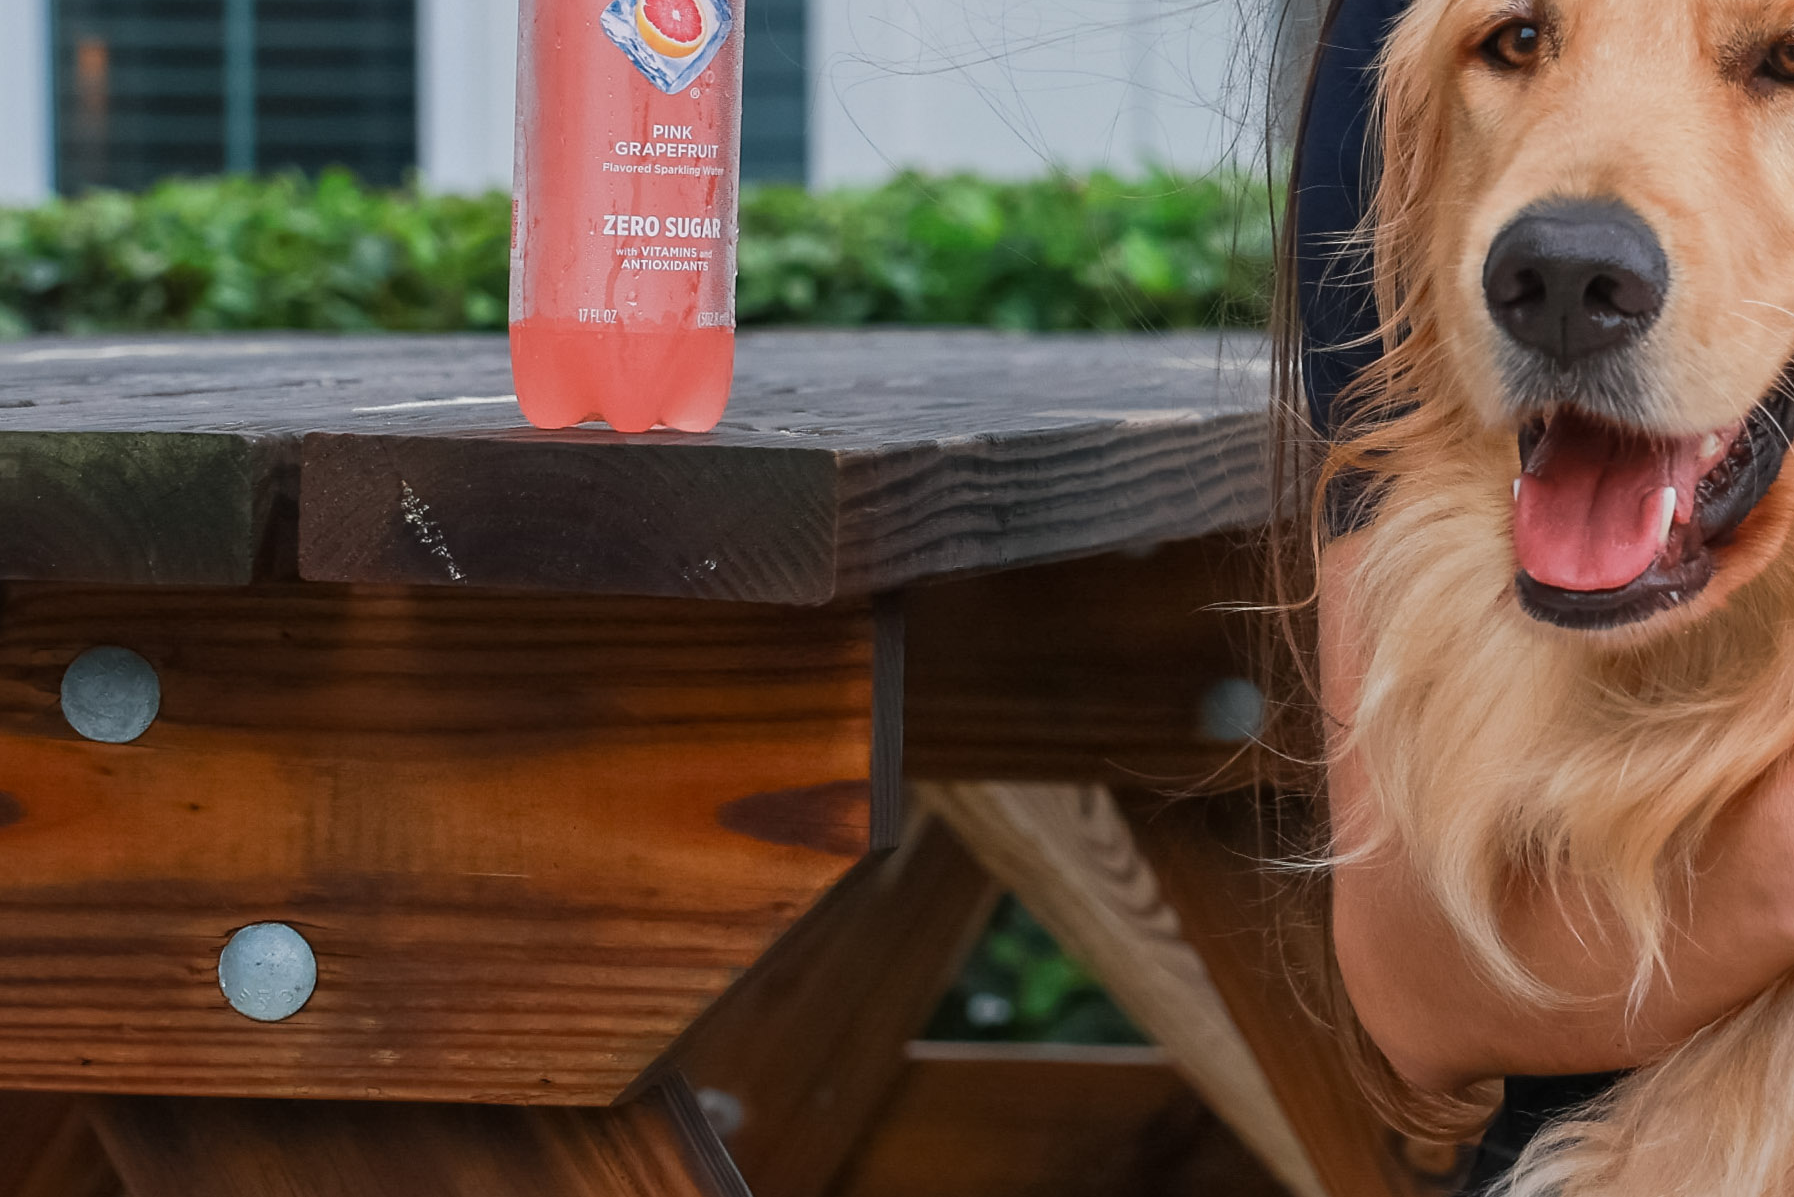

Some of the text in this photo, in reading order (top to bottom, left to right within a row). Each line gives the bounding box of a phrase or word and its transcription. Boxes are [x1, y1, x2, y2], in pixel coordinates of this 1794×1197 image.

[653, 124, 693, 140] PINK
[615, 141, 719, 159] GRAPEFRUIT
[602, 162, 652, 174] Flavored
[654, 164, 701, 177] Sparkling
[603, 214, 721, 239] ZERO SUGAR
[616, 246, 638, 257] with
[641, 246, 698, 259] VITAMINS
[621, 259, 709, 272] ANTIOXIDANTS
[578, 308, 618, 324] 17 FL OZ
